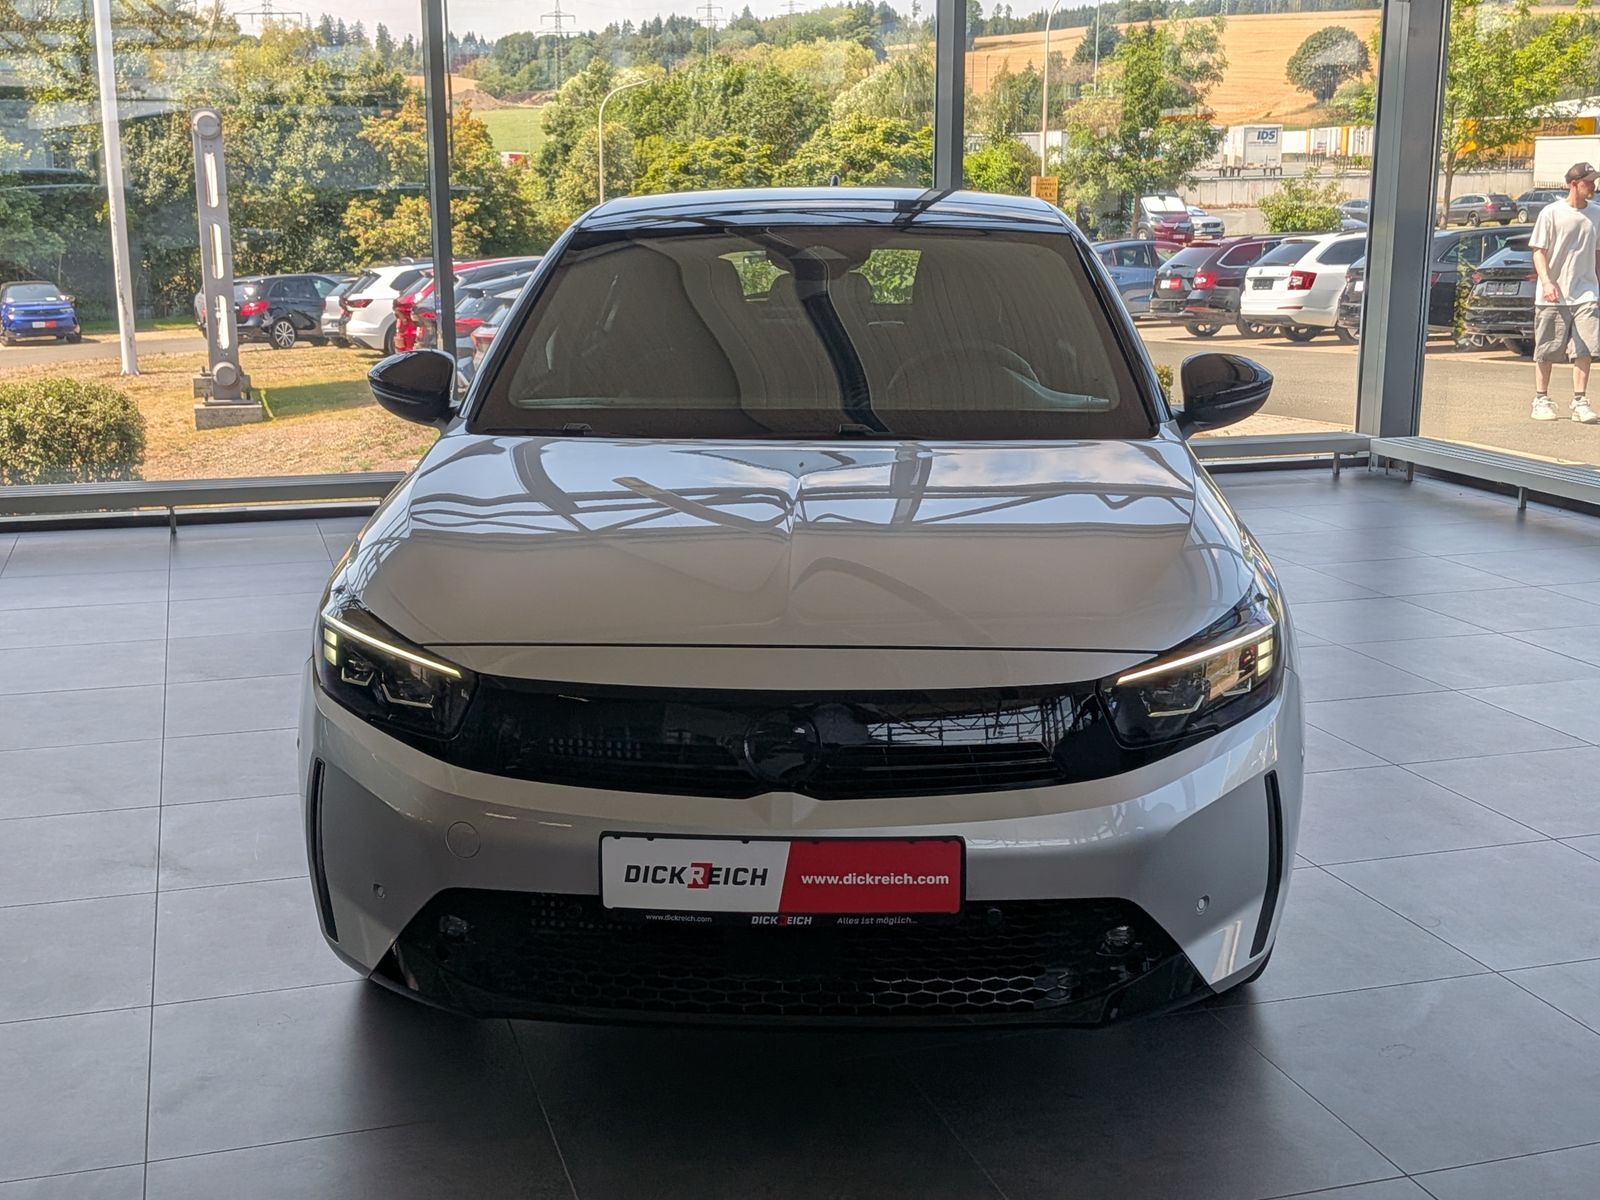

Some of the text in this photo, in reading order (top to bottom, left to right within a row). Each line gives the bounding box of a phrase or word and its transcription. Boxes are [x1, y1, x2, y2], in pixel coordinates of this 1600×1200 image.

[1257, 130, 1276, 140] IDS
[624, 863, 769, 888] DICKREICH
[801, 872, 950, 885] www.dickreich.com
[645, 914, 713, 923] www.dickreich.com
[751, 915, 812, 926] DICKREICH
[837, 916, 860, 925] Alles
[861, 916, 874, 925] ist
